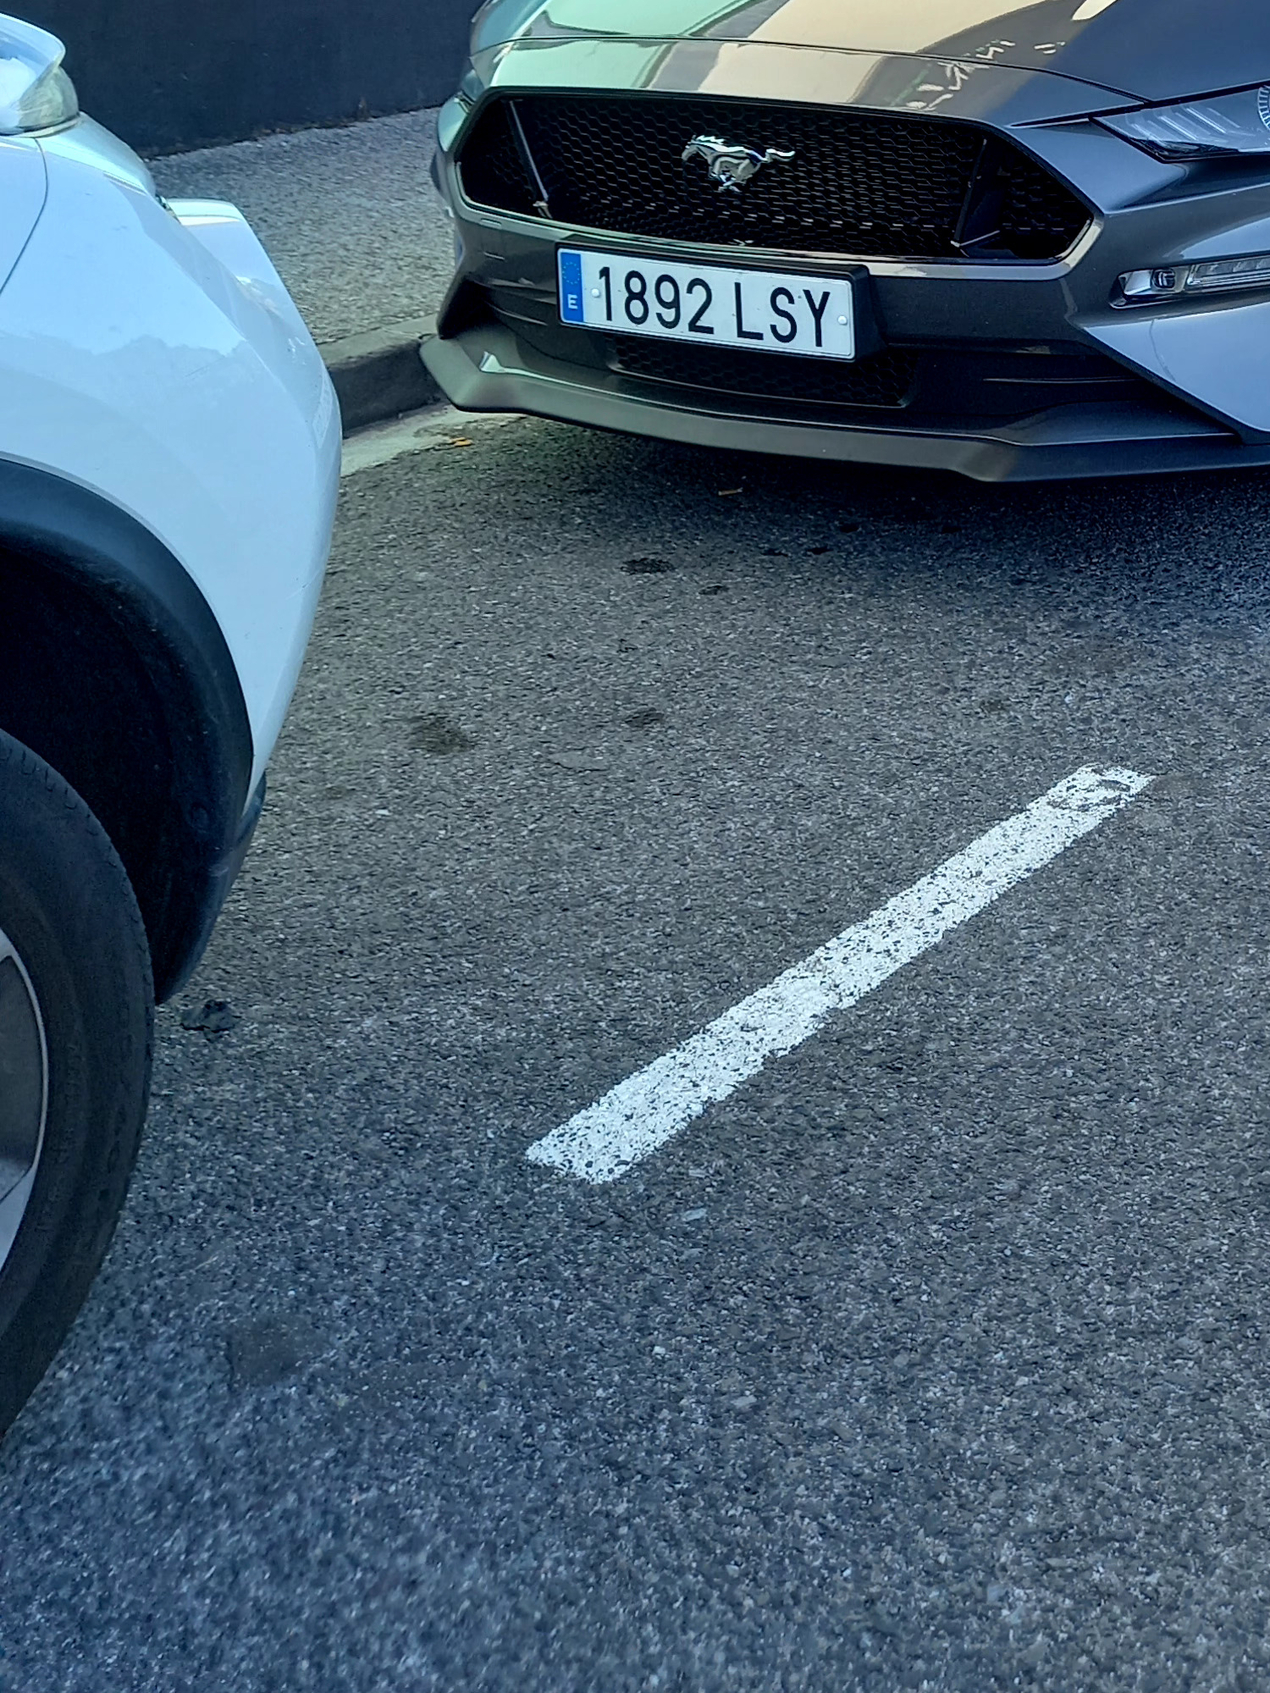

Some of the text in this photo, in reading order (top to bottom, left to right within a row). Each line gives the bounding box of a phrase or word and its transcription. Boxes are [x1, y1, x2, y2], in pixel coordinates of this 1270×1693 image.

[567, 294, 578, 309] E
[599, 266, 831, 348] 1892 LSY
